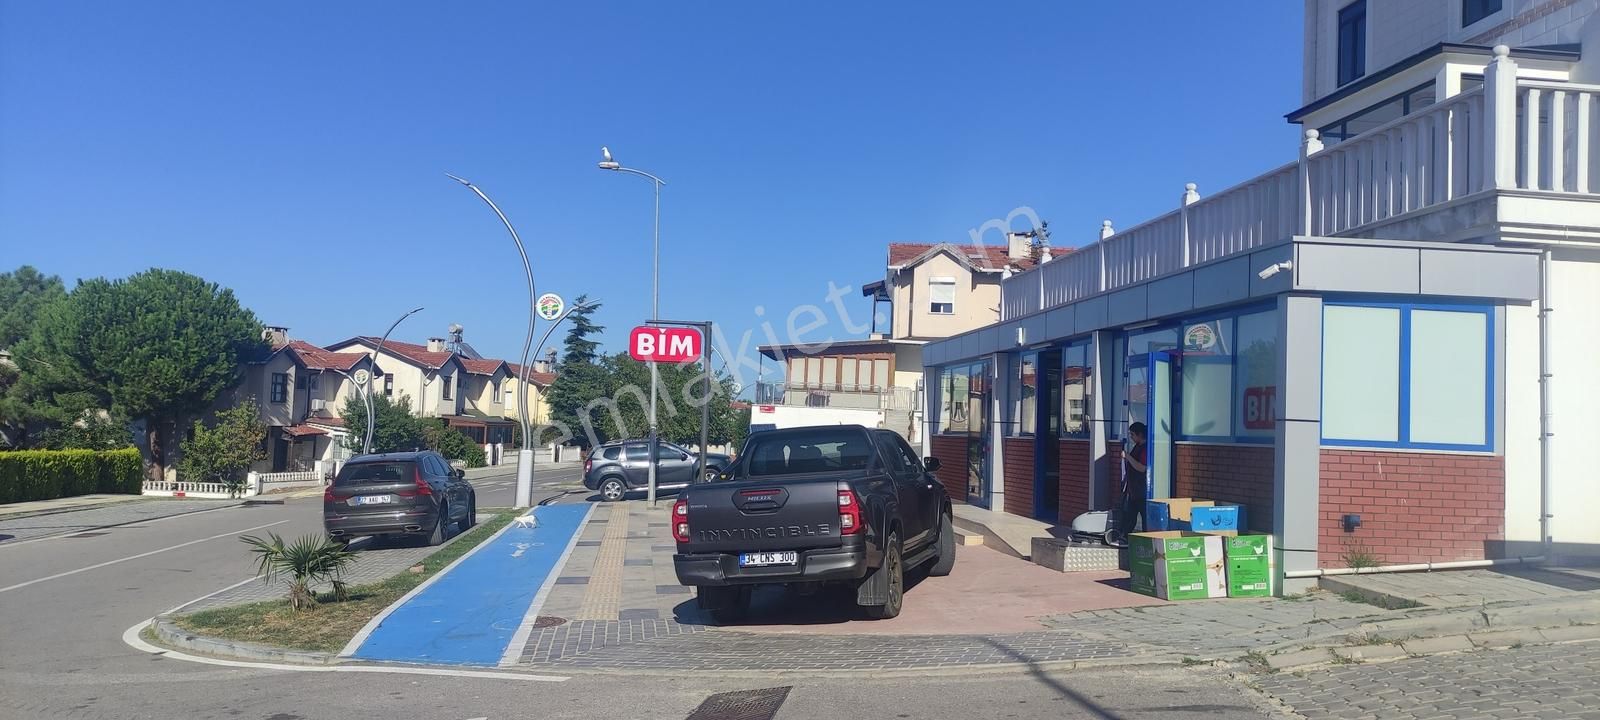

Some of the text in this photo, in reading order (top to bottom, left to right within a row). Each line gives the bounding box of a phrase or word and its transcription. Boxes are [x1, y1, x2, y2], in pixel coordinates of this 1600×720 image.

[637, 328, 694, 357] BİM
[700, 523, 831, 542] INVINCIBLE
[746, 552, 795, 564] 34 CNS 300
